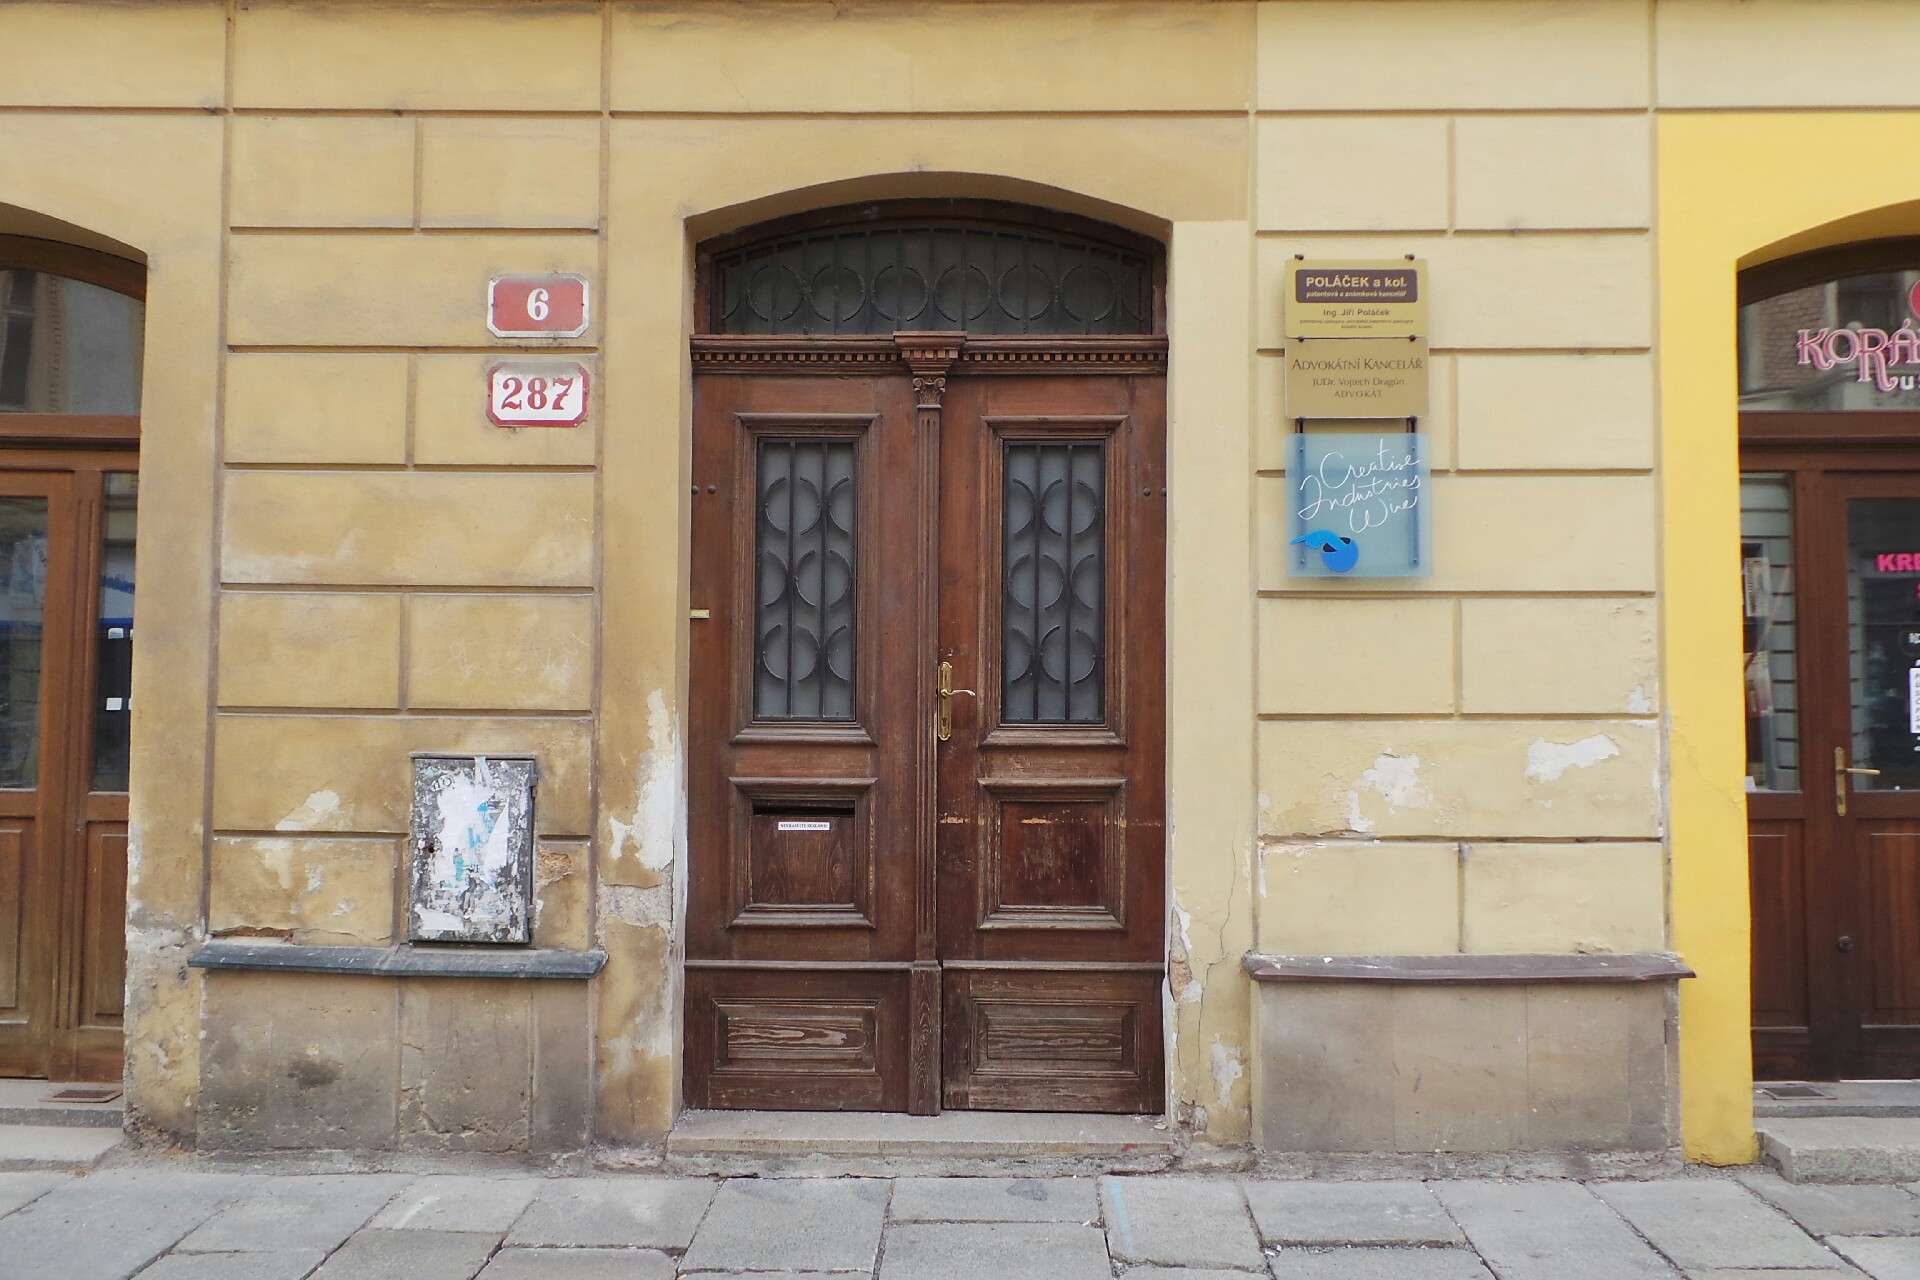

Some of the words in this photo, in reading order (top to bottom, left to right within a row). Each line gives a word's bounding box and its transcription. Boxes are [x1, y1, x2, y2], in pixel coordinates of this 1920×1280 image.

[1306, 274, 1369, 288] POLÁČEK
[1373, 279, 1381, 287] a
[1384, 276, 1407, 288] kol.
[527, 287, 549, 321] 6
[1796, 318, 1920, 392] KORÁ
[501, 377, 574, 410] 287
